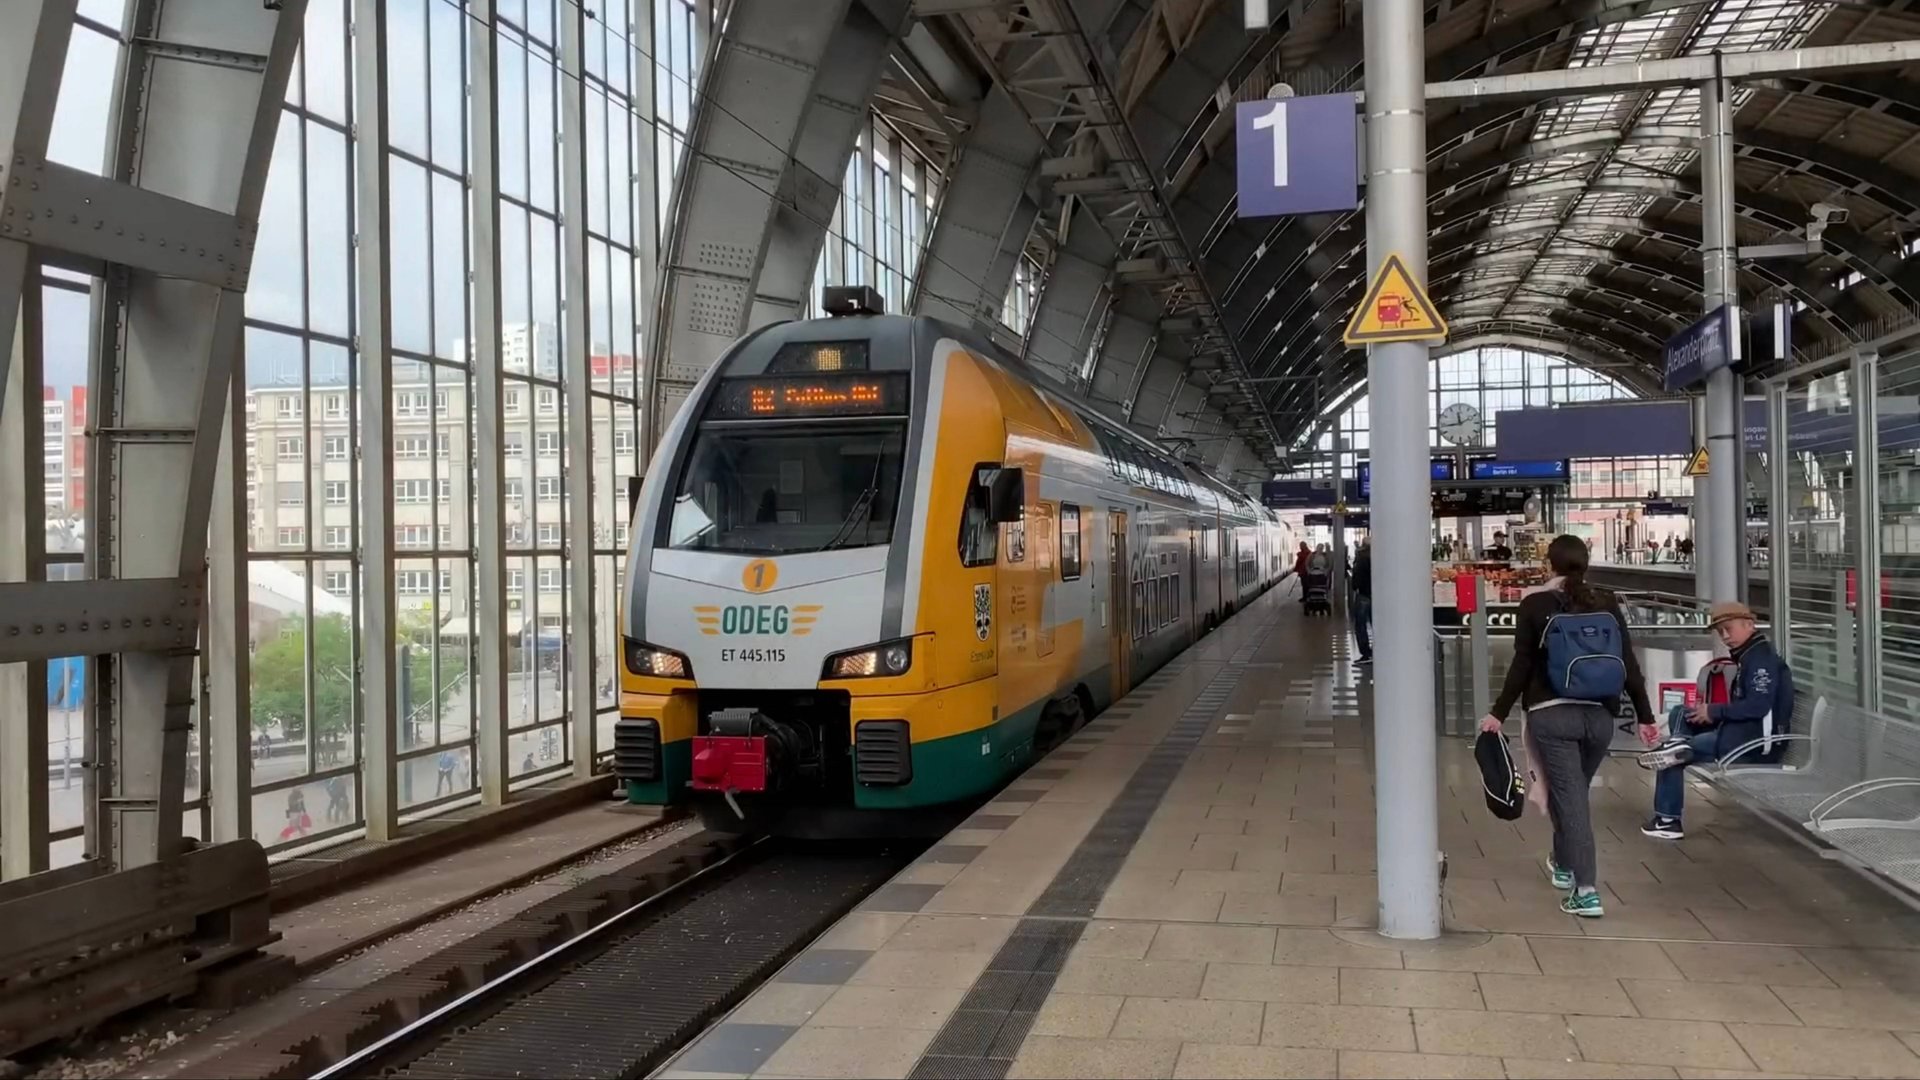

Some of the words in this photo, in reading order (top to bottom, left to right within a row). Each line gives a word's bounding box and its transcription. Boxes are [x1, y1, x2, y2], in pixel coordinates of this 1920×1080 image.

[1253, 101, 1288, 187] 1
[1555, 461, 1563, 472] 2
[753, 563, 766, 588] 1
[721, 604, 789, 635] ODEG
[721, 648, 736, 662] ET
[739, 648, 786, 662] 445.115
